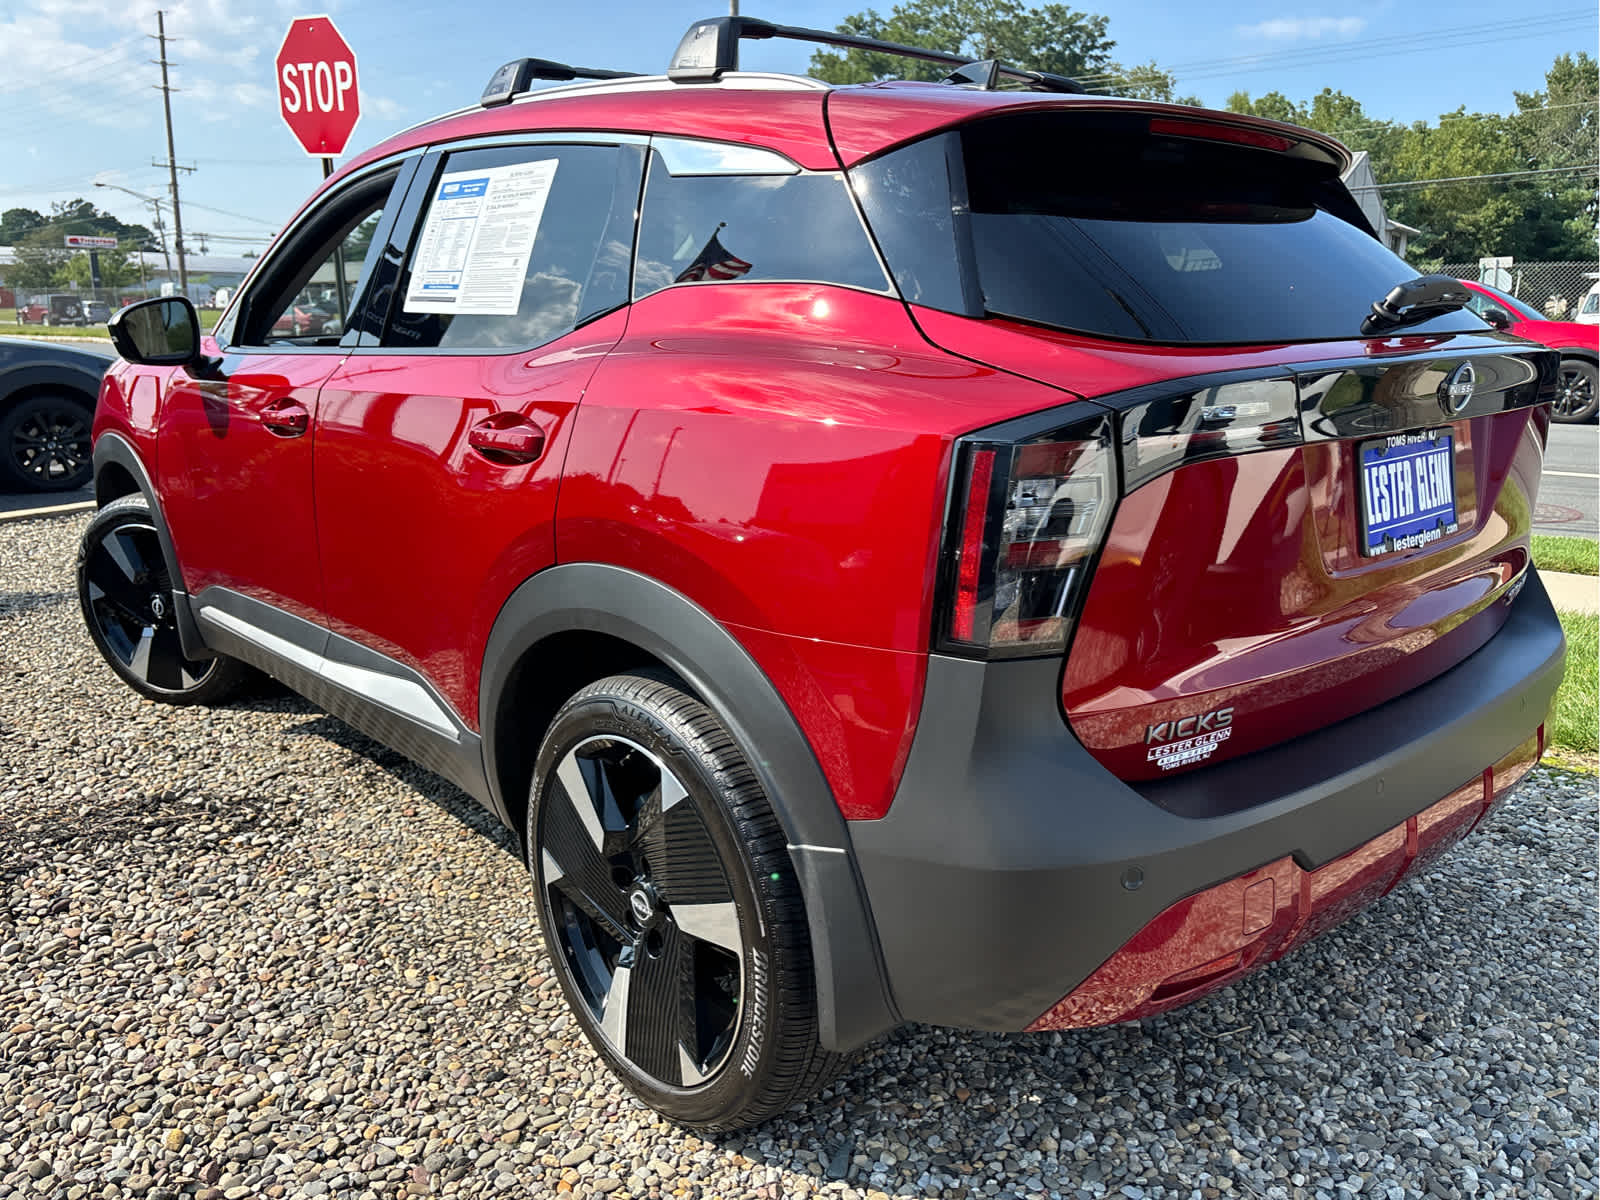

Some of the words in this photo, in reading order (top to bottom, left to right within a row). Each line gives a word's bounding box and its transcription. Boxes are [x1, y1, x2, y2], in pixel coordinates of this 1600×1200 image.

[282, 60, 353, 113] STOP
[1386, 434, 1406, 449] TOMS
[1364, 460, 1415, 526] LESTER
[1415, 451, 1453, 512] GLENN
[1145, 707, 1235, 744] KICKS
[1147, 739, 1193, 759] LESTER
[1194, 728, 1232, 747] GLENN
[740, 947, 769, 1080] BRIDGESTONE
